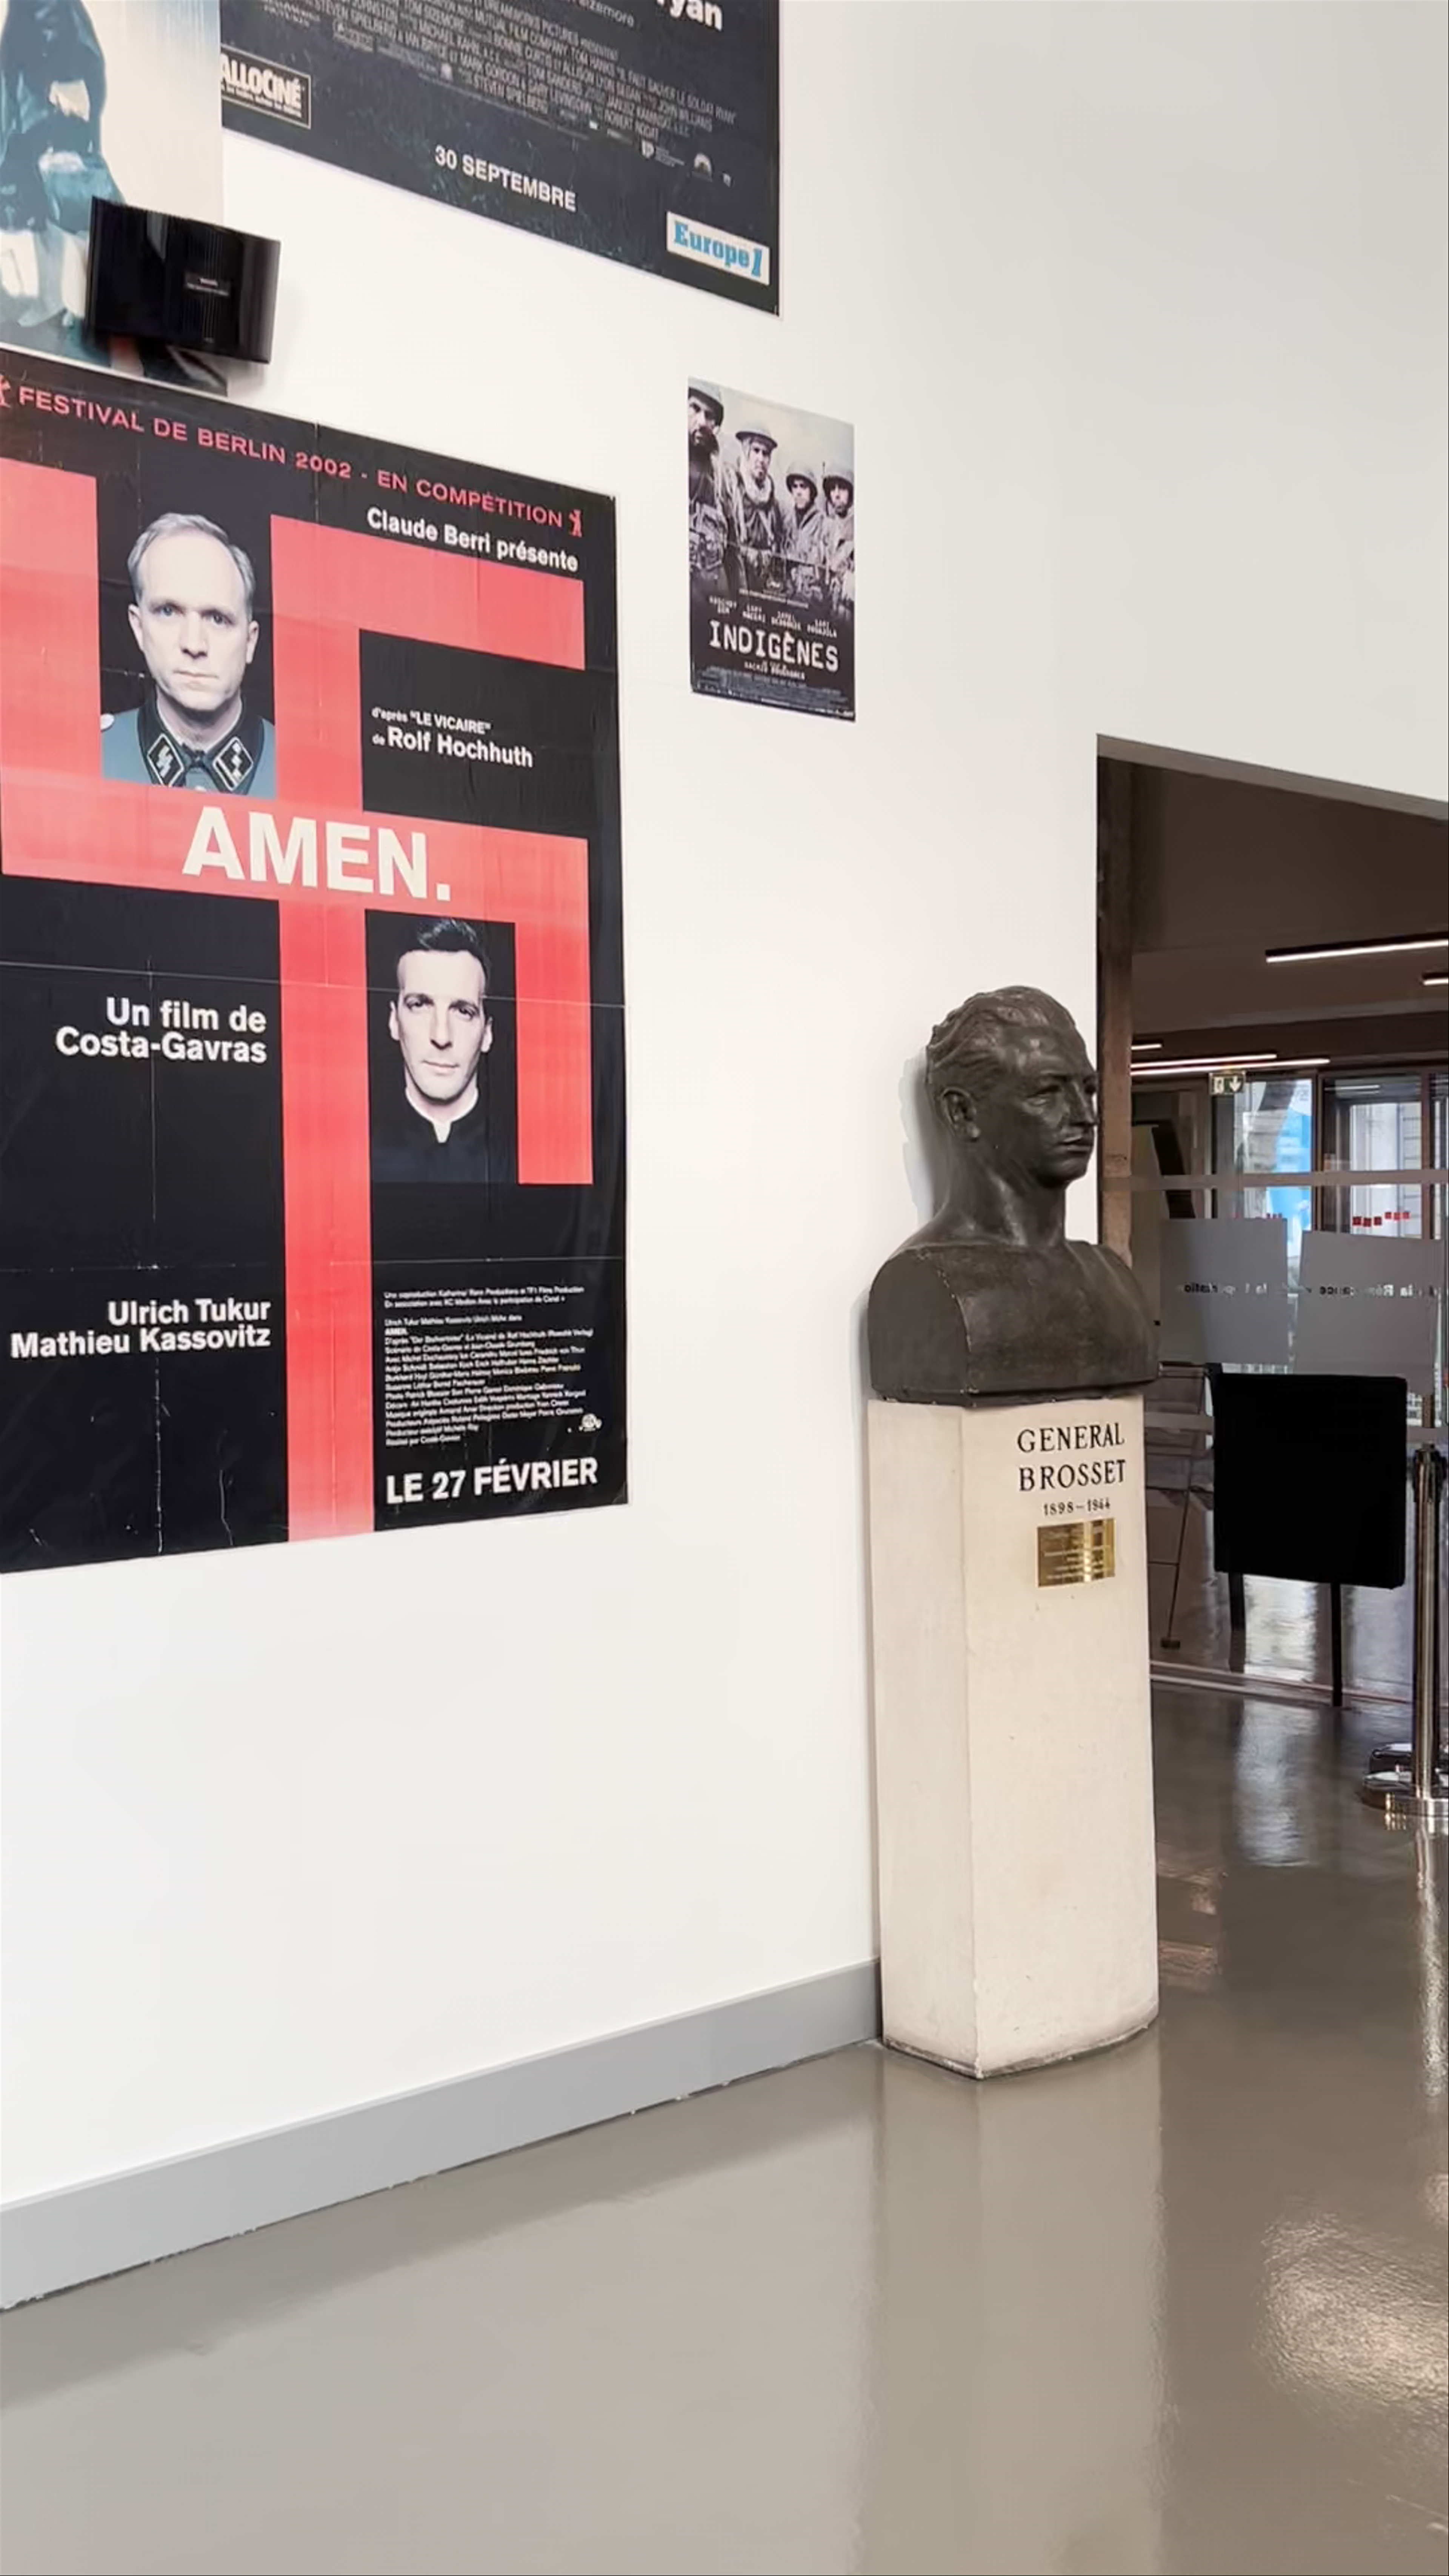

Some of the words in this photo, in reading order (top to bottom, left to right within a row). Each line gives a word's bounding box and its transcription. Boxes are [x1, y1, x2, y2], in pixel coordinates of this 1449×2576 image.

[655, 0, 722, 31] yan
[435, 145, 457, 169] 30
[463, 154, 576, 213] SEPTEMBRE
[19, 386, 144, 432] FESTIVAL
[154, 418, 187, 441] DE
[198, 428, 285, 464] BERLIN
[296, 452, 351, 478] 2002
[378, 470, 407, 492] EN
[416, 478, 563, 528] COMPÉTITION
[367, 507, 438, 541] Claude
[444, 524, 490, 553] Berri
[497, 538, 578, 572] présente
[709, 620, 838, 672] INDIGÈNES
[372, 707, 408, 723] d'après
[434, 714, 491, 737] VICAIRE"
[372, 734, 385, 746] de
[388, 722, 432, 752] Rolf
[438, 730, 532, 767] Hochhuth
[182, 806, 450, 901] AMEN.
[106, 997, 150, 1027] Un
[160, 1001, 219, 1030] film
[229, 1005, 267, 1033] de
[55, 1026, 267, 1063] Costa-Gavras
[108, 1300, 189, 1326] Ulrich
[195, 1297, 271, 1322] Tukur
[11, 1330, 130, 1358] Mathieu
[139, 1324, 271, 1352] Kassovitz
[1017, 1423, 1124, 1452] GENERAL
[387, 1473, 423, 1504] LE
[432, 1470, 466, 1499] 27
[474, 1457, 597, 1495] FÉVRIER
[1019, 1459, 1126, 1491] BROSSET
